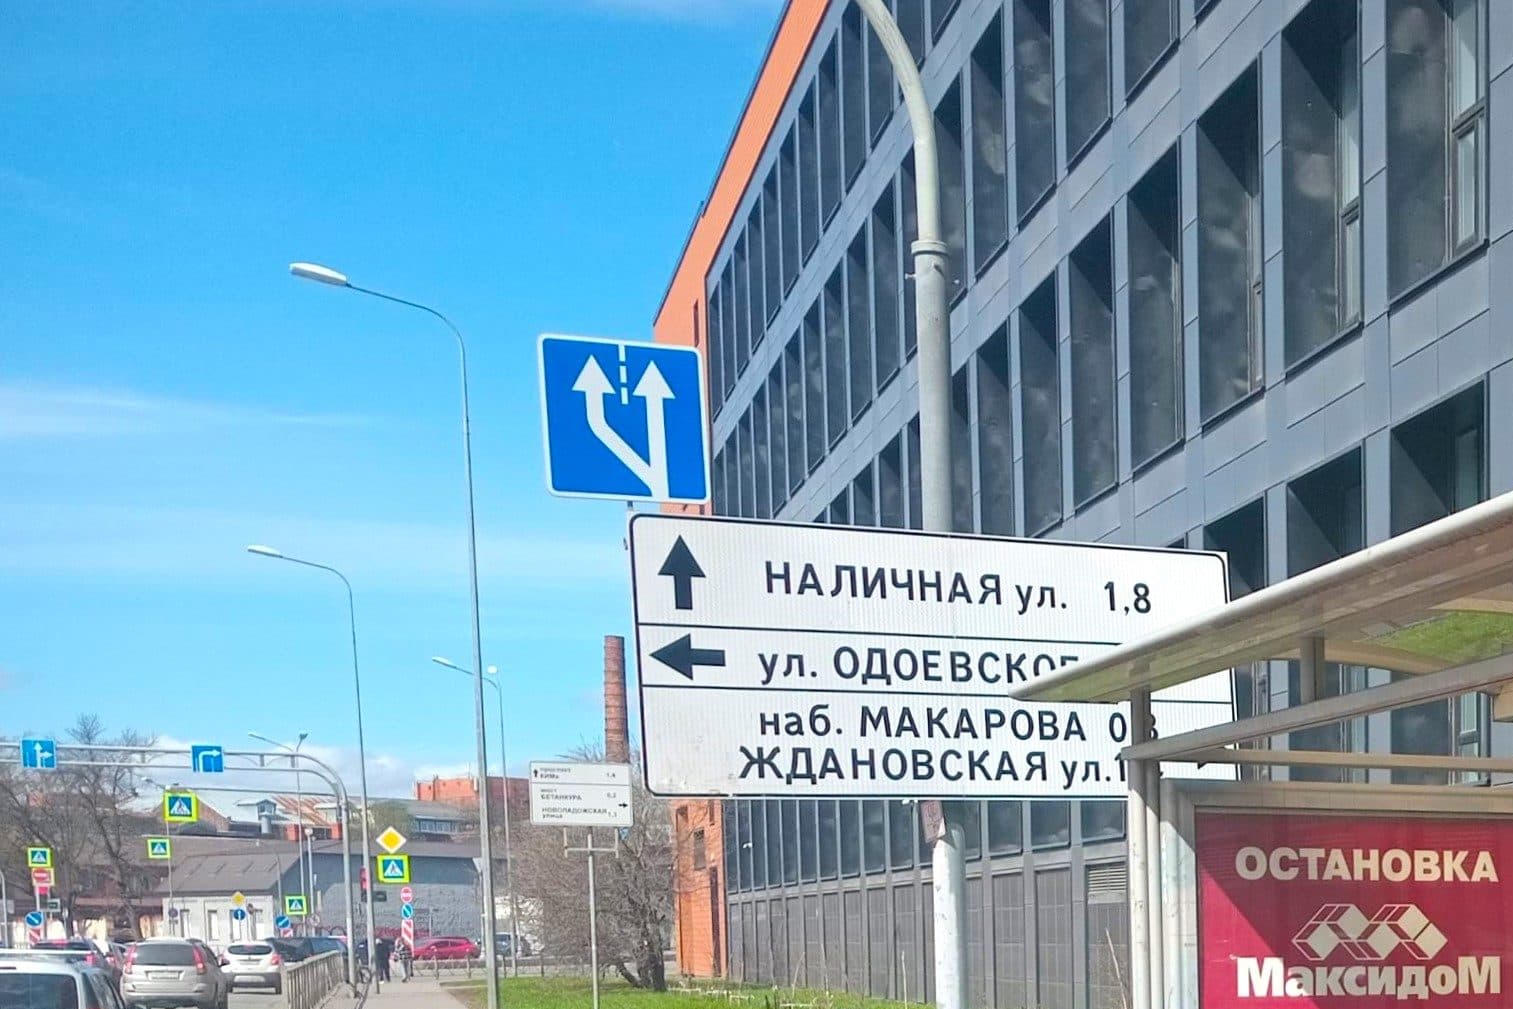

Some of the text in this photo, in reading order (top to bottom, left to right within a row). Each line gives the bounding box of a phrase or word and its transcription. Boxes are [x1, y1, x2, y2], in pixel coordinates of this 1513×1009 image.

[765, 560, 1151, 615] НАЛИЧНАЯ ул. 1,8
[757, 653, 818, 685] ул.
[760, 703, 843, 737] наб.
[860, 705, 1087, 742] МАКАРОВА
[738, 745, 1047, 785] ЖДАНОВСКАЯ
[1235, 846, 1499, 882] ОСТАНОВКА
[1236, 956, 1500, 1000] МаксидоМ
